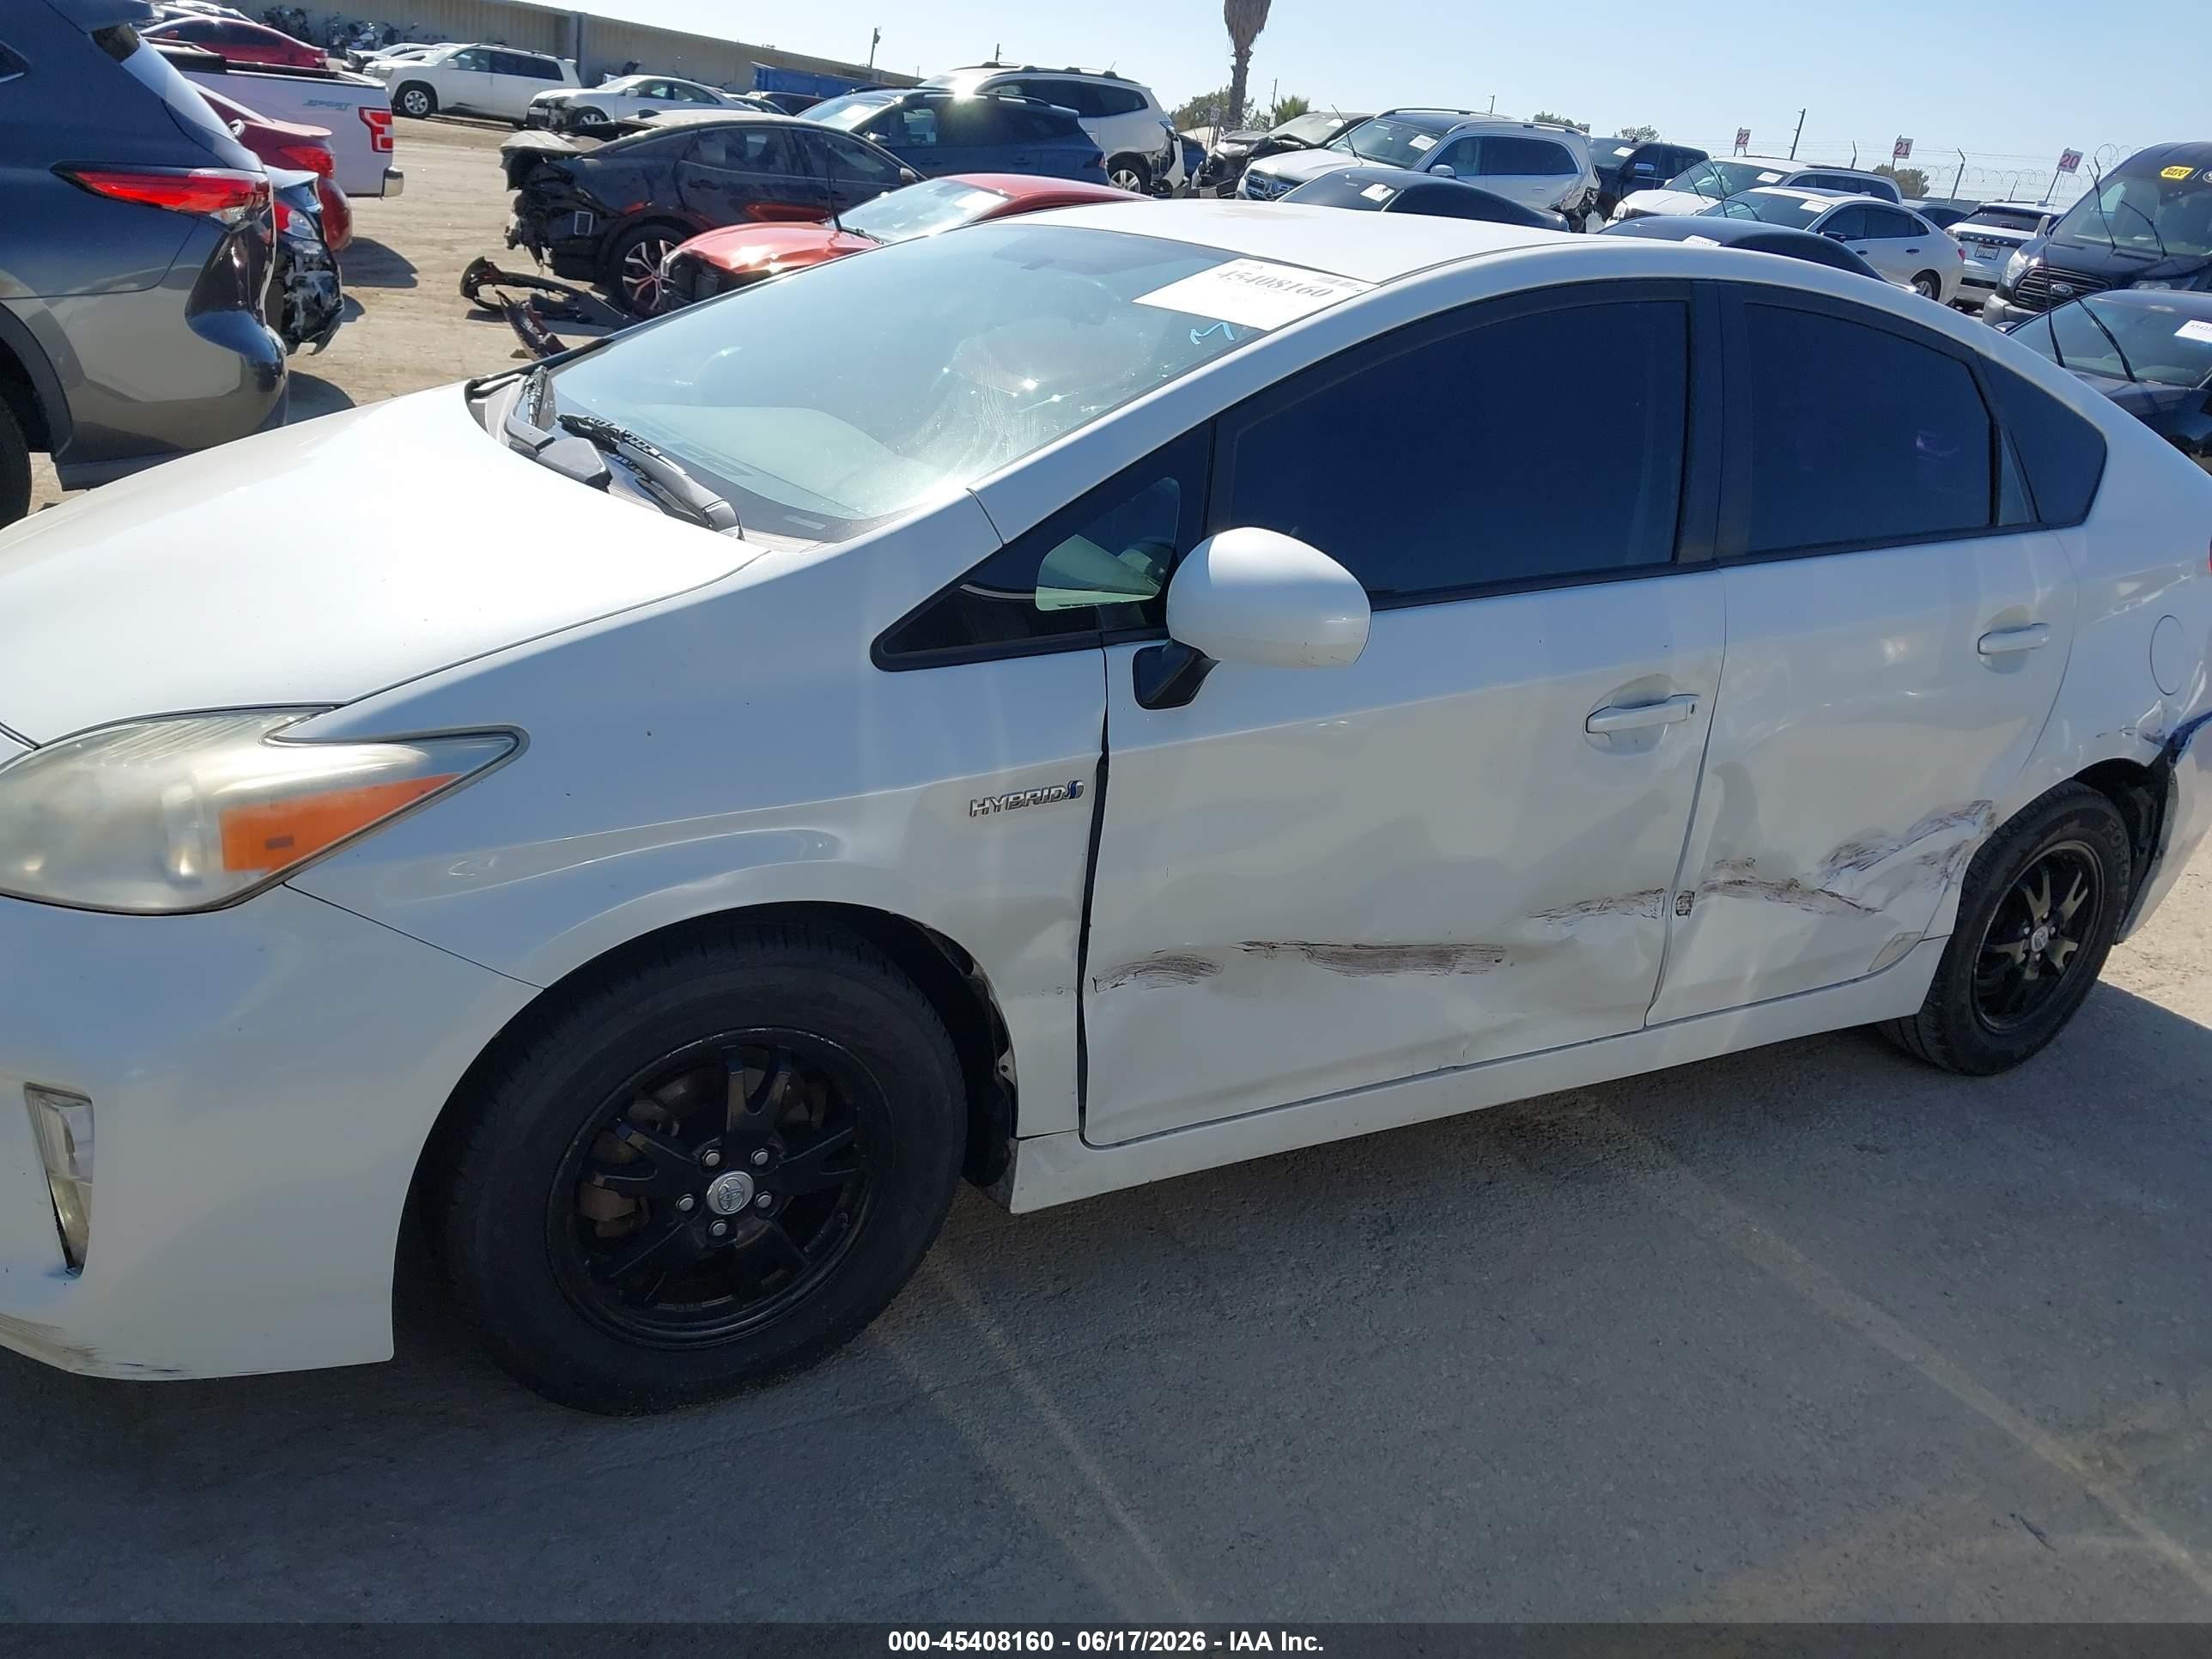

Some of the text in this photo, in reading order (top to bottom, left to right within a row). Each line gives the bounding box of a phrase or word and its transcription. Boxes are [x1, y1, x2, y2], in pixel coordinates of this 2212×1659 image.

[1736, 133, 1749, 144] 22
[1894, 142, 1910, 155] 21
[2060, 154, 2079, 169] 20
[1216, 270, 1334, 297] 45408160
[969, 785, 1067, 817] HYBRID
